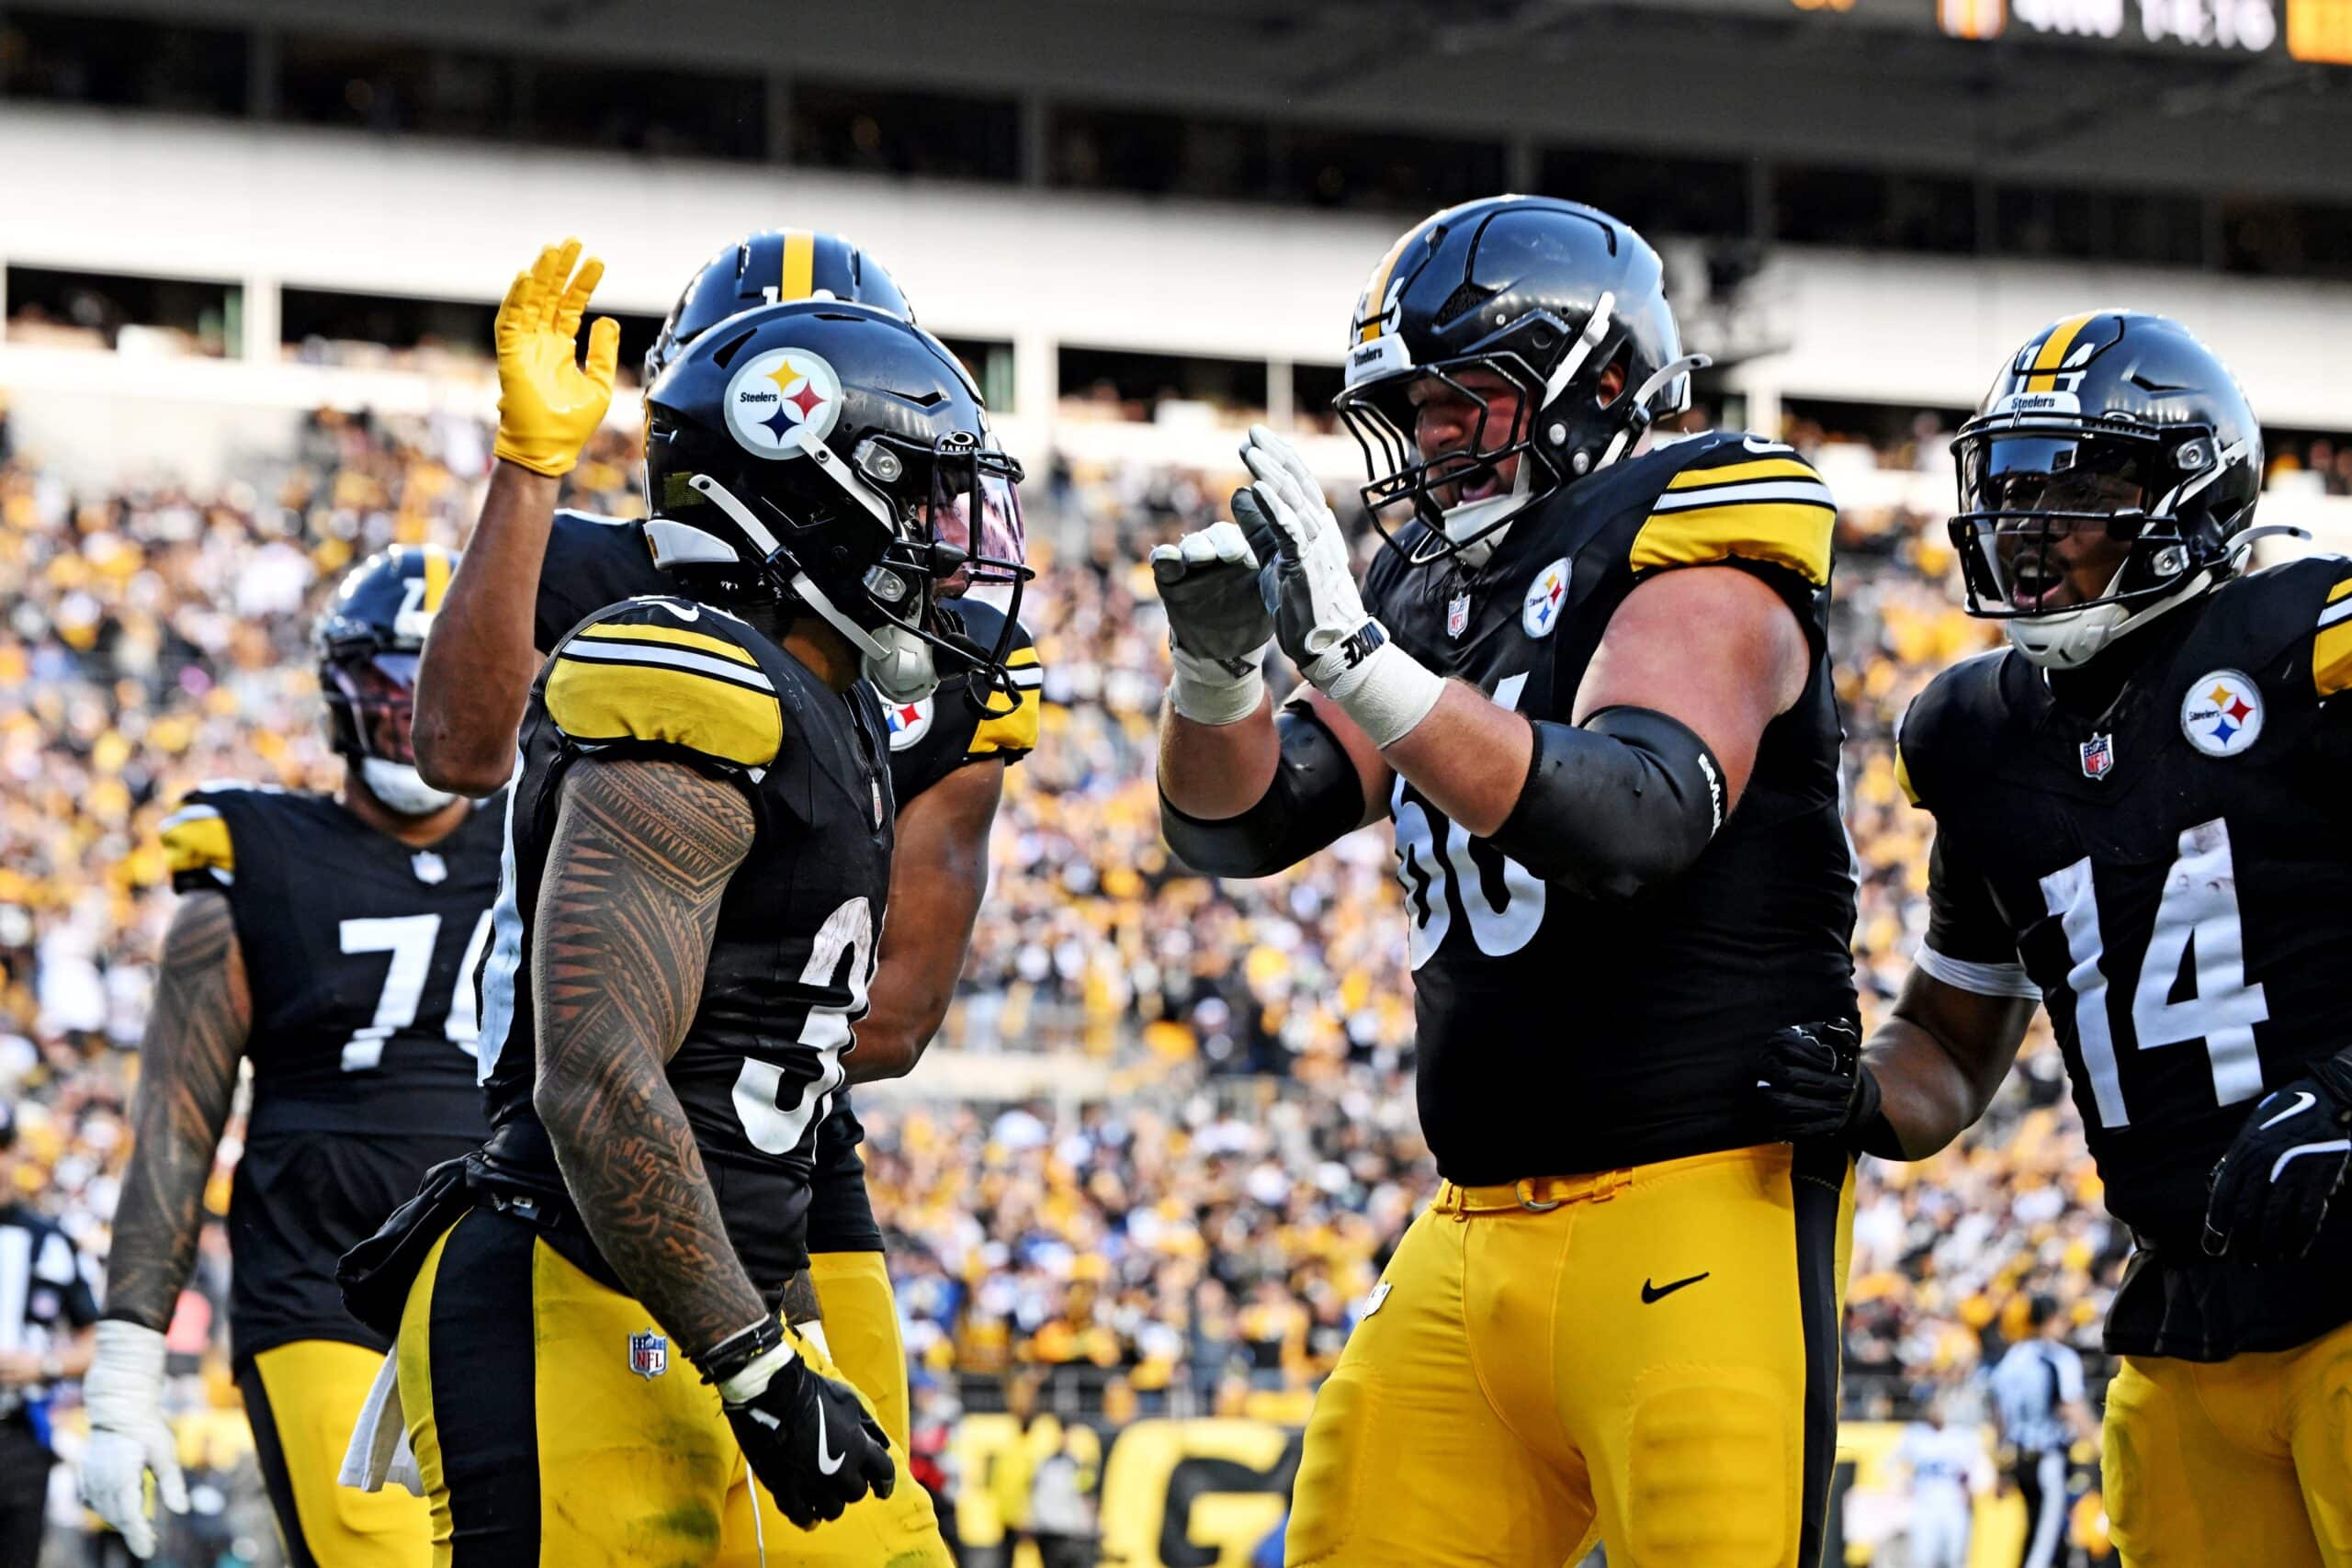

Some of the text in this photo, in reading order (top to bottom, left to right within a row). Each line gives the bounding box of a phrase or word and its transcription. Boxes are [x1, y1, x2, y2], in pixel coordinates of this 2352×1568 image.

[2014, 343, 2095, 392] 14
[740, 390, 778, 403] Steelers
[2011, 395, 2056, 410] Steelers
[2086, 750, 2109, 773] NFL
[2038, 816, 2270, 1129] 14
[636, 1350, 663, 1371] NFL
